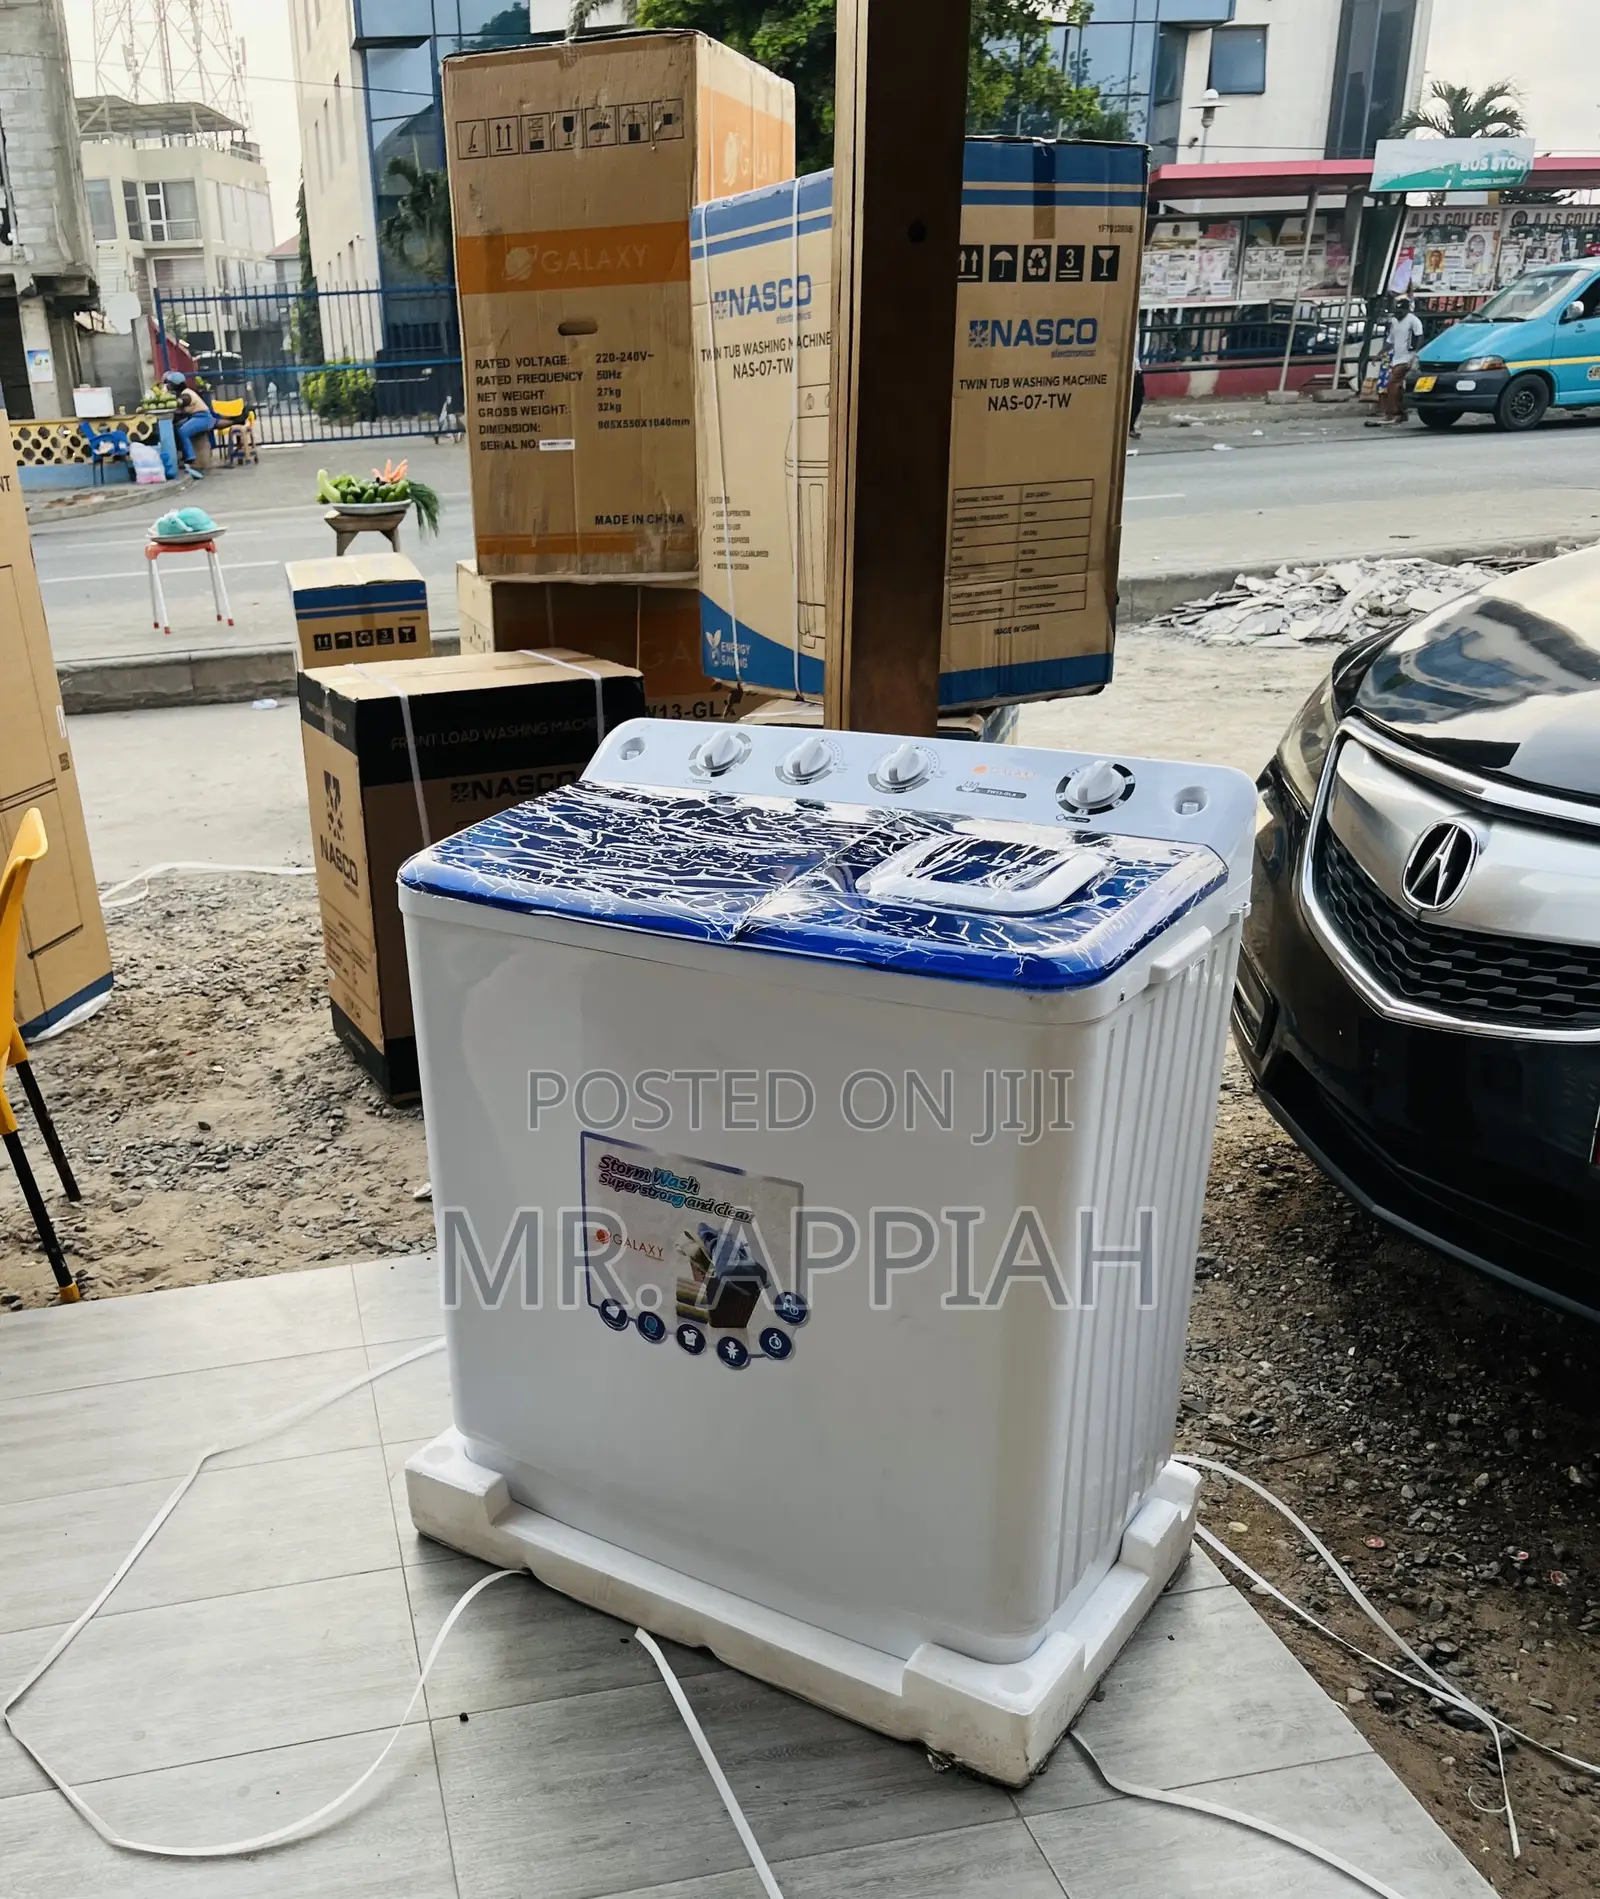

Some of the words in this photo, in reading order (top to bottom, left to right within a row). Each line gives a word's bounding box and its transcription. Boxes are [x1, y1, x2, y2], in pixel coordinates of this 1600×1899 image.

[1445, 211, 1500, 226] COLLEGE
[541, 245, 650, 273] GALAXY
[729, 274, 812, 318] NASCO
[990, 318, 1098, 347] NASCO
[723, 344, 741, 359] TUB
[743, 337, 786, 355] WASHING
[475, 358, 511, 370] RATED
[733, 358, 794, 380] NAS-07-TW
[476, 374, 512, 386] RATED
[516, 371, 584, 384] FREQUENCY
[959, 379, 987, 390] TWIN
[990, 377, 1010, 389] TUB
[1012, 375, 1060, 388] WASHING
[1062, 374, 1108, 386] MACHINE
[477, 391, 497, 403] NET
[597, 388, 622, 398] 27kg
[597, 402, 622, 413] 32kg
[987, 393, 1072, 411] NAS-07-TW
[478, 406, 518, 418] GROSS
[479, 422, 541, 435] DIMENSION:
[480, 439, 518, 450] SERIAL
[595, 514, 629, 525] MADE
[632, 514, 644, 525] IN
[721, 655, 749, 669] SAVNG
[390, 732, 437, 750] FRNT
[441, 729, 479, 745] LOAD
[483, 722, 548, 741] WASHING
[320, 834, 358, 887] NASCO
[599, 1154, 650, 1183] Storm
[651, 1167, 700, 1195] Wash
[599, 1172, 640, 1193] Super
[639, 1184, 686, 1208] strong
[685, 1196, 715, 1214] and
[612, 1232, 665, 1258] GALAXY
